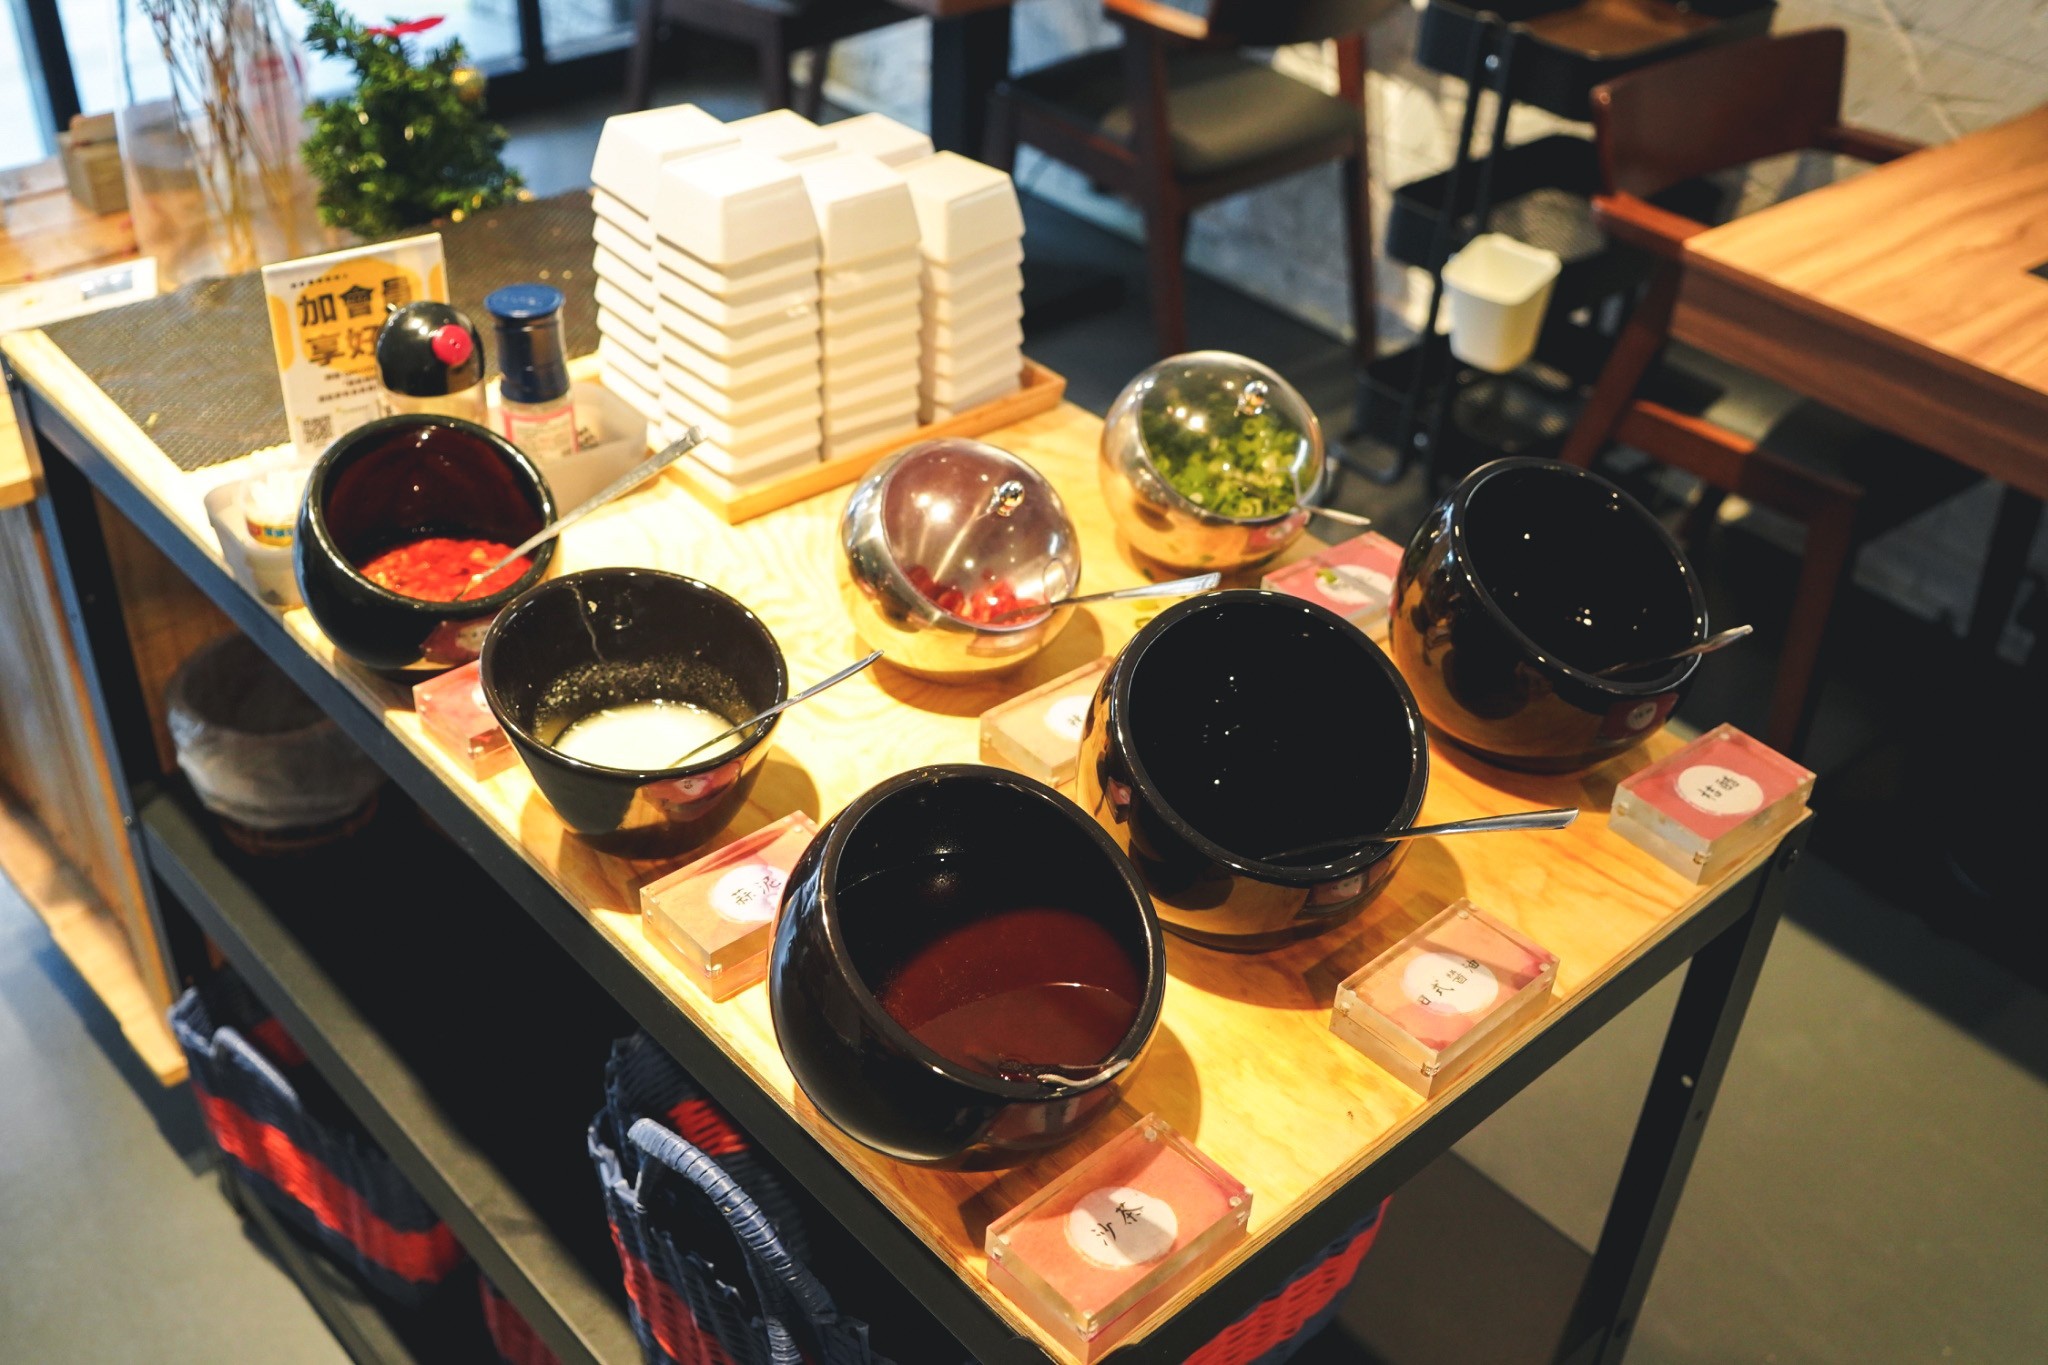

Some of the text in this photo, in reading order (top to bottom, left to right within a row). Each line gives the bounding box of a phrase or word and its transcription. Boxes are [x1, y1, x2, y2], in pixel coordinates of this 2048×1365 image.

[730, 876, 781, 905] 蒜泥
[1417, 959, 1480, 1006] 日式醬油
[1091, 1202, 1144, 1246] 沙茶
